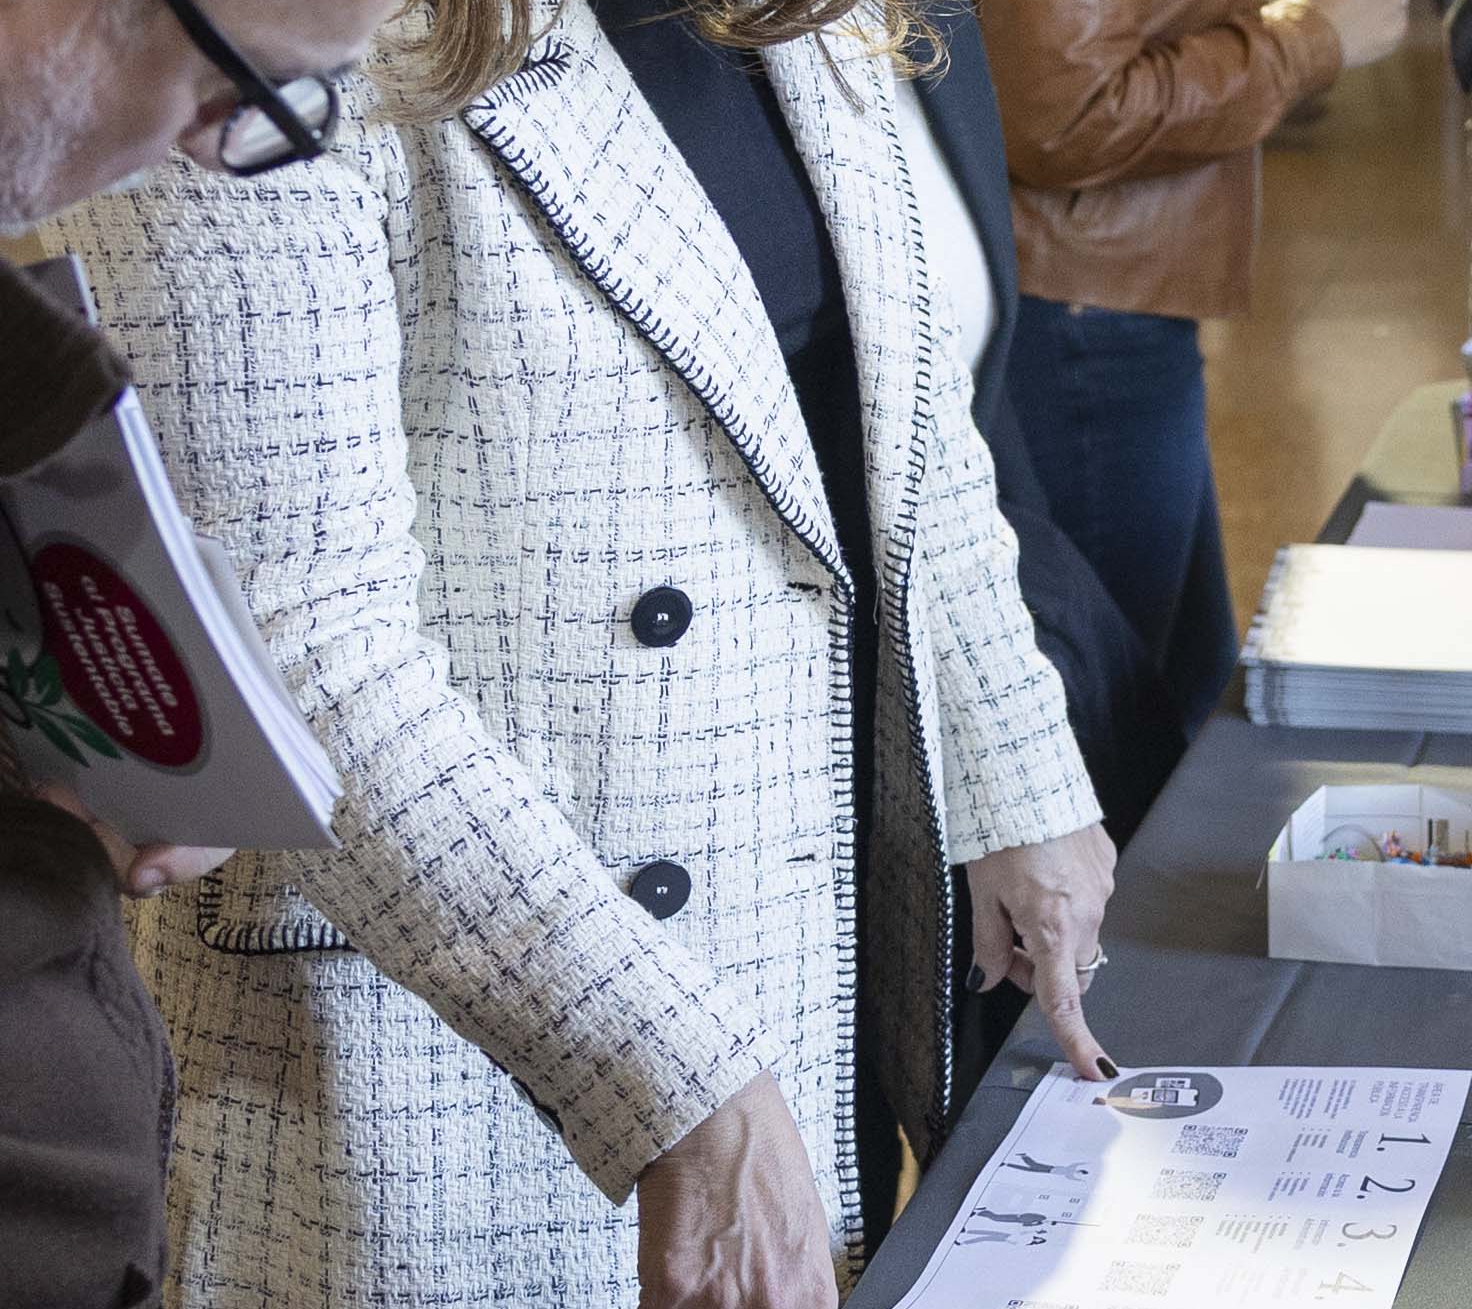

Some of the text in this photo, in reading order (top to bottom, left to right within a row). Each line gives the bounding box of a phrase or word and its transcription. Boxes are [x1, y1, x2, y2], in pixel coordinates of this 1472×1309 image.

[43, 582, 133, 736] Sustentable
[75, 608, 139, 710] Justicia
[96, 607, 175, 735] Programa
[115, 606, 177, 707] Sumate
[1336, 1222, 1397, 1248] 3.
[1356, 1176, 1415, 1200] 2.
